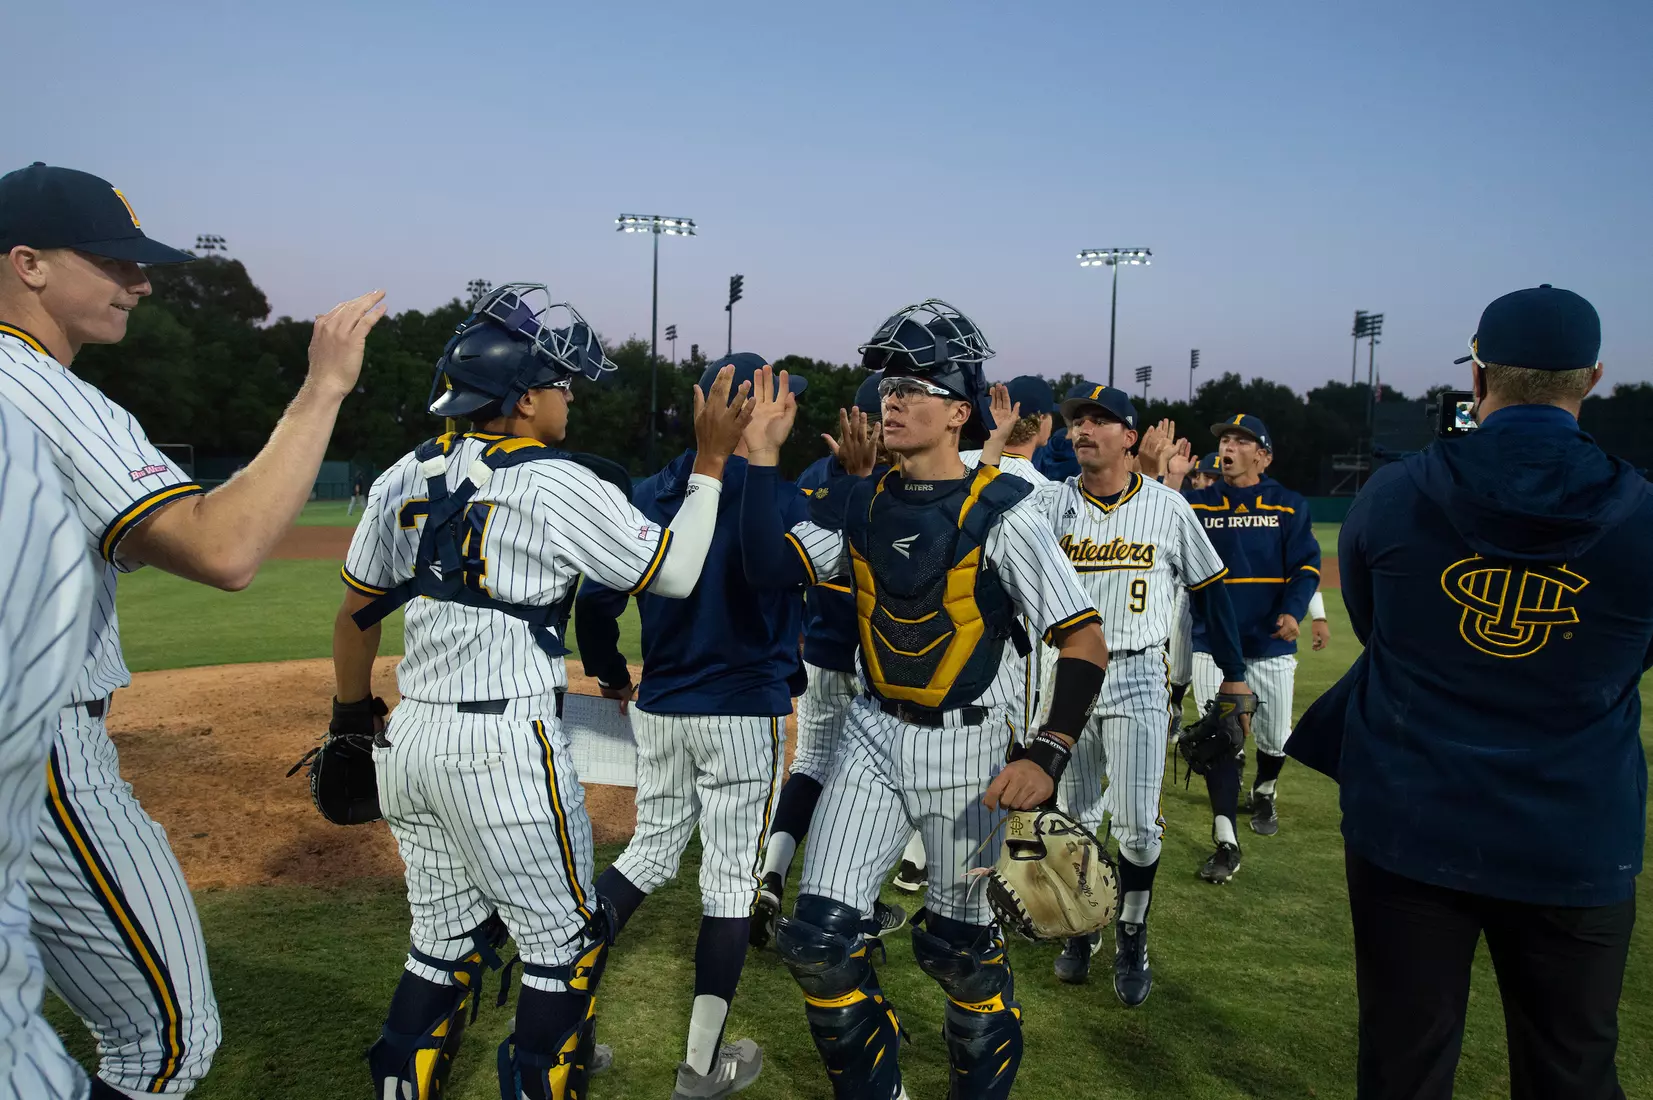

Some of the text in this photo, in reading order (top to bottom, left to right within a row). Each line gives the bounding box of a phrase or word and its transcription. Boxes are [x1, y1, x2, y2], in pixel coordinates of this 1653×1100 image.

[1204, 515, 1279, 528] UC IRVINE
[398, 498, 495, 600] 4
[1059, 534, 1157, 566] Anteaters
[1129, 577, 1148, 614] 9
